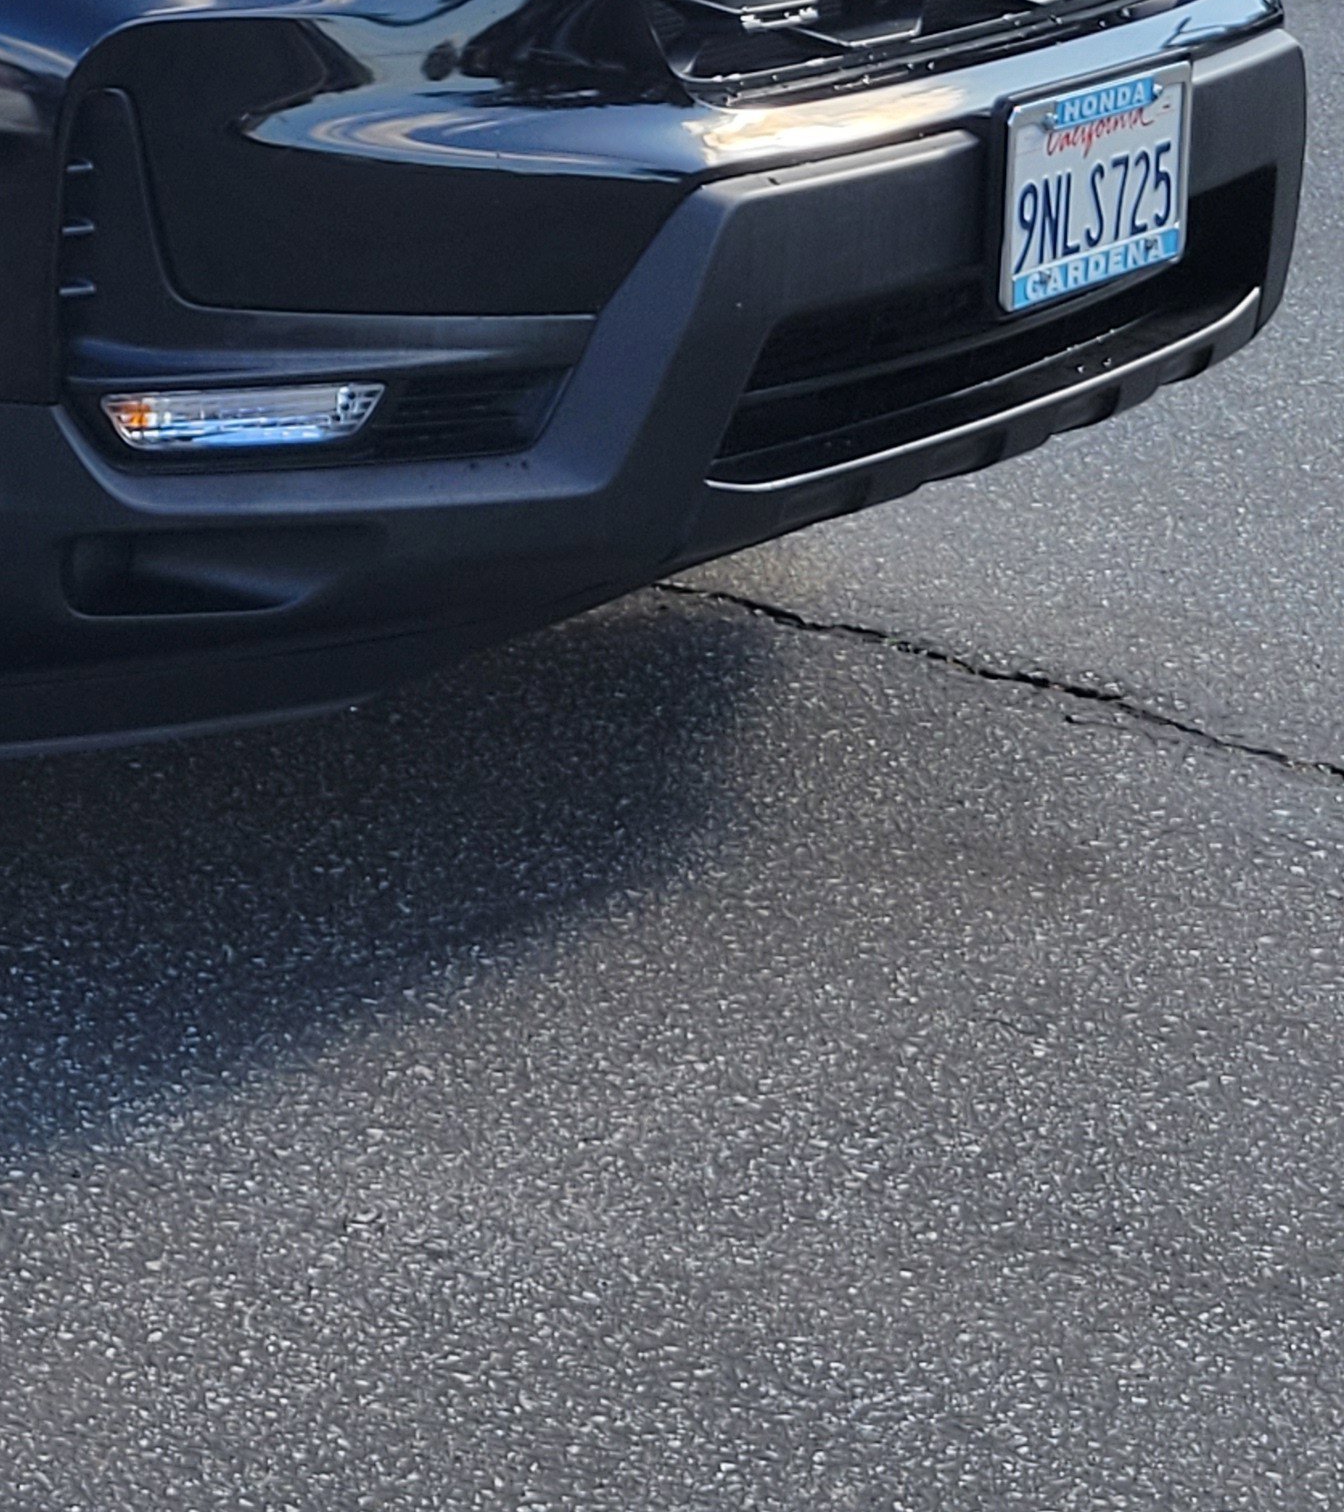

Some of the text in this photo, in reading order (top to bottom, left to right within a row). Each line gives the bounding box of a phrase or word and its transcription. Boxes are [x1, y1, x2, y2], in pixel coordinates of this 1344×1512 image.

[1061, 82, 1147, 124] HONDA
[1014, 140, 1172, 274] 9NLS725
[1024, 235, 1164, 301] GARDENA
